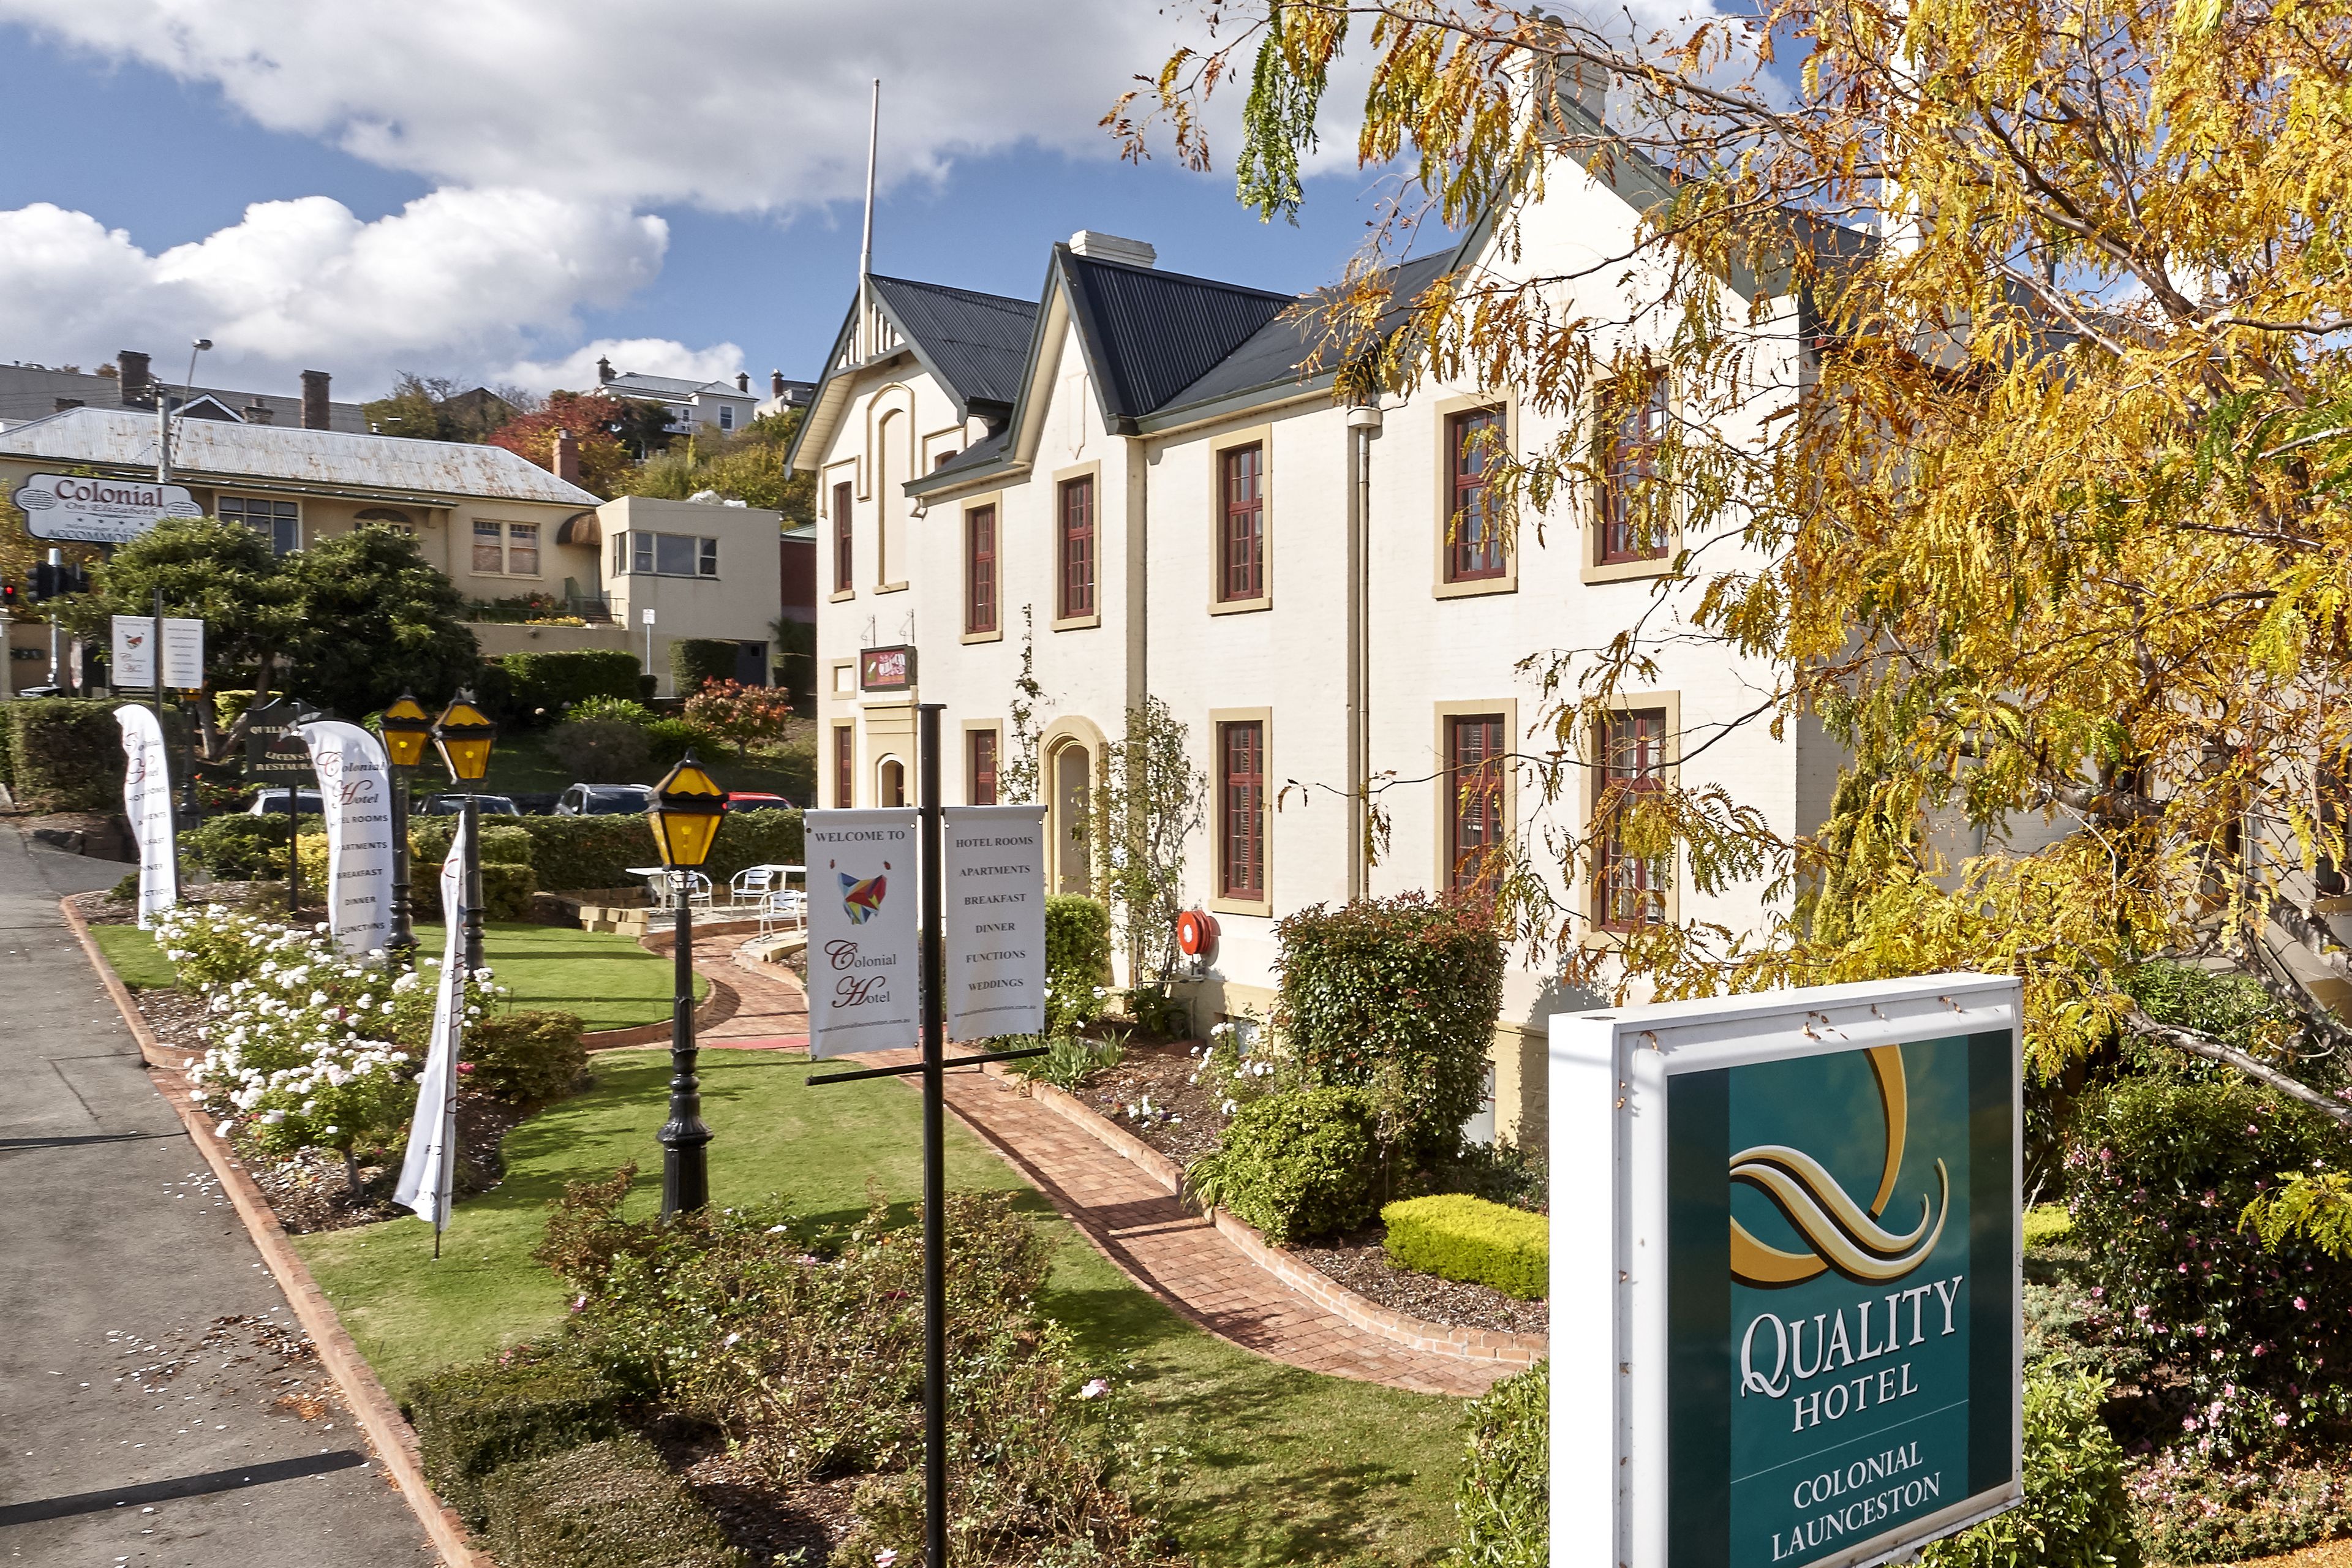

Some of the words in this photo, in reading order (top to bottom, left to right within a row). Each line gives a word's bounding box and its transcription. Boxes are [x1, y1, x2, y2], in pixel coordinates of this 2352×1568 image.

[56, 480, 164, 507] Colonial
[91, 503, 157, 516] Elizabeth
[47, 529, 135, 542] ACCOMMOD
[316, 751, 386, 777] Colonial
[333, 779, 379, 809] Hotel
[352, 815, 389, 824] ROOMS
[815, 831, 884, 842] WELCOME
[887, 830, 905, 840] TO
[956, 838, 993, 848] HOTEL
[995, 837, 1034, 846] ROOMS
[337, 869, 383, 879] BREAKFAST
[959, 865, 1031, 877] APARTMENTS
[345, 896, 377, 906] DINNER
[964, 894, 1027, 905] BREAKFAST
[976, 922, 1016, 933] DINNER
[824, 939, 897, 971] Colonial
[966, 950, 1026, 963] FUNCTIONS
[968, 978, 1024, 991] WEDDINGS
[832, 976, 890, 1008] Hotel
[1740, 1275, 1963, 1398] QUALITY
[1792, 1363, 1919, 1433] HOTEL
[1793, 1441, 1923, 1509] COLONIAL
[1772, 1472, 1940, 1562] LAUNCESTON
